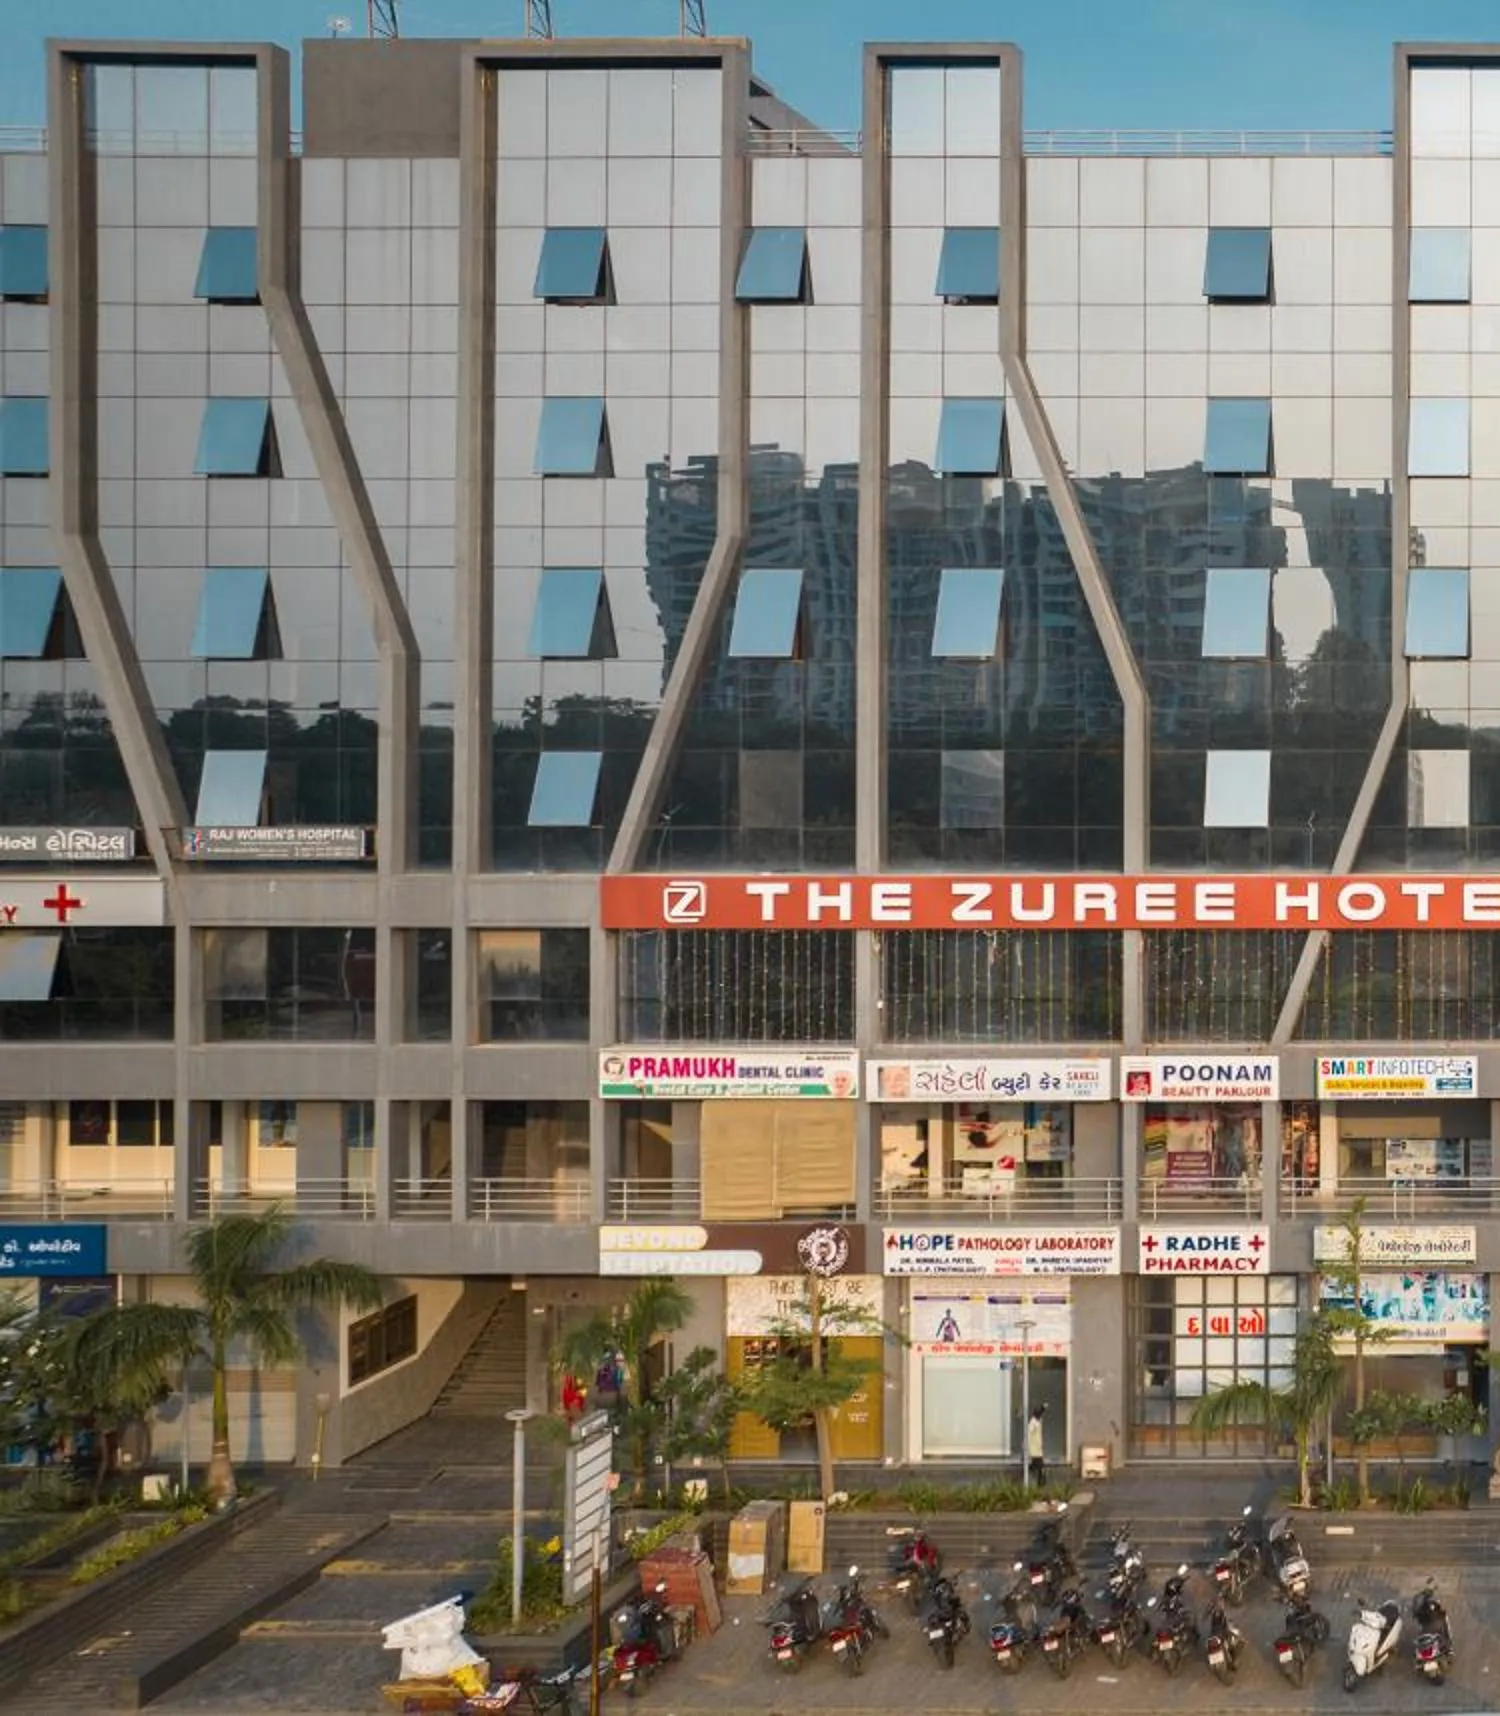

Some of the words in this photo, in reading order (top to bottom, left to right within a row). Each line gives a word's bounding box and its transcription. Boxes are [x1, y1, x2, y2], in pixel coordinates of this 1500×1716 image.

[46, 829, 125, 850] હોસ્પિટલ
[209, 829, 234, 841] RAJ
[237, 829, 295, 841] WOMEN'S
[298, 829, 358, 841] HOSPITAL
[746, 882, 912, 921] THE
[951, 882, 1235, 921] ZUREE
[628, 1057, 736, 1079] PRAMUKH
[738, 1066, 781, 1079] DENTAL
[785, 1066, 825, 1079] CLINIC
[1162, 1065, 1272, 1082] POONAM
[1321, 1060, 1375, 1075] SMART
[1377, 1060, 1445, 1075] INFOTECH
[1161, 1086, 1210, 1097] BEAUTY
[1215, 1086, 1272, 1097] PARLOUR
[900, 1234, 955, 1251] HOPE
[958, 1237, 1031, 1251] PATHOLOGY
[1035, 1237, 1115, 1251] LABORATORY
[1166, 1236, 1241, 1251] RADHE
[1145, 1258, 1261, 1271] PHARMACY
